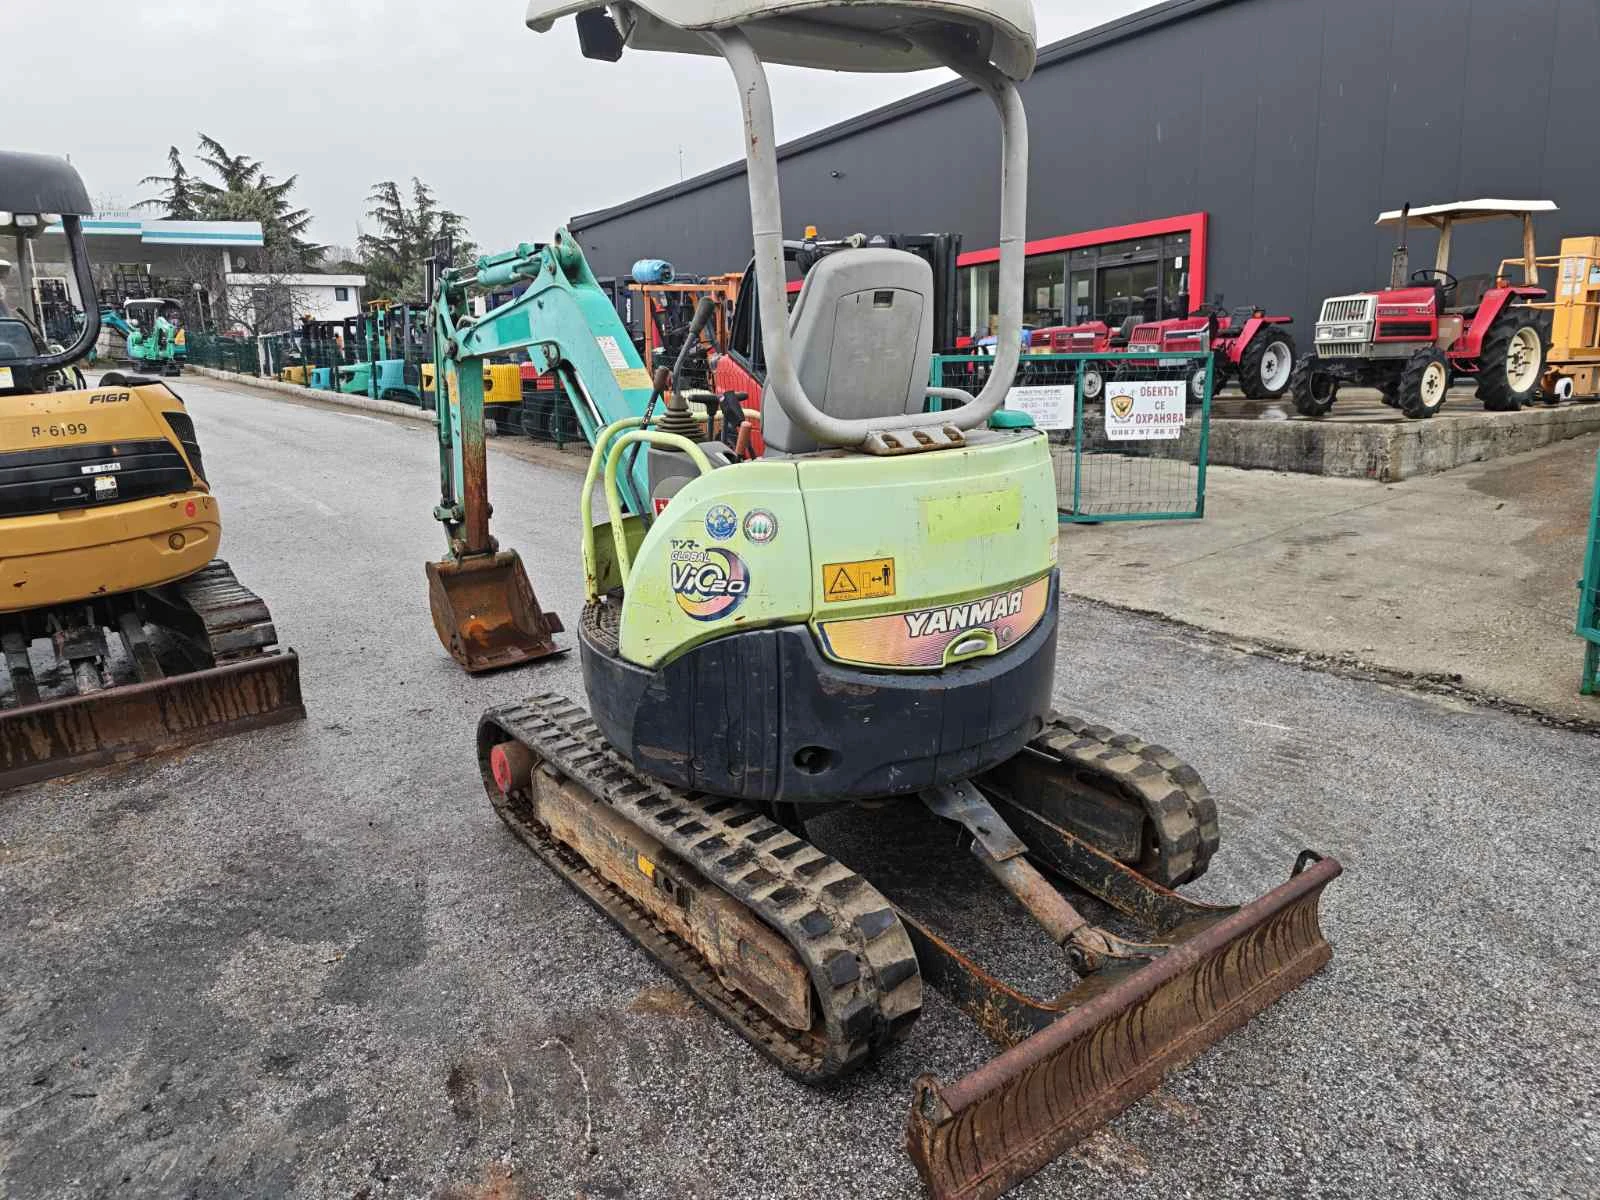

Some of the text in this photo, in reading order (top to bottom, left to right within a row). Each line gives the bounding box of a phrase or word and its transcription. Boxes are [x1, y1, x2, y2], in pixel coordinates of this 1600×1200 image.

[1140, 386, 1179, 398] ОБЕКТЪТ
[89, 392, 130, 405] FIGA
[1154, 400, 1166, 410] СЕ
[1135, 412, 1184, 425] ОХРАНЯВА
[670, 540, 700, 550] ヤンマー
[671, 551, 712, 562] GLOBAL
[903, 590, 1024, 638] YANMAR
